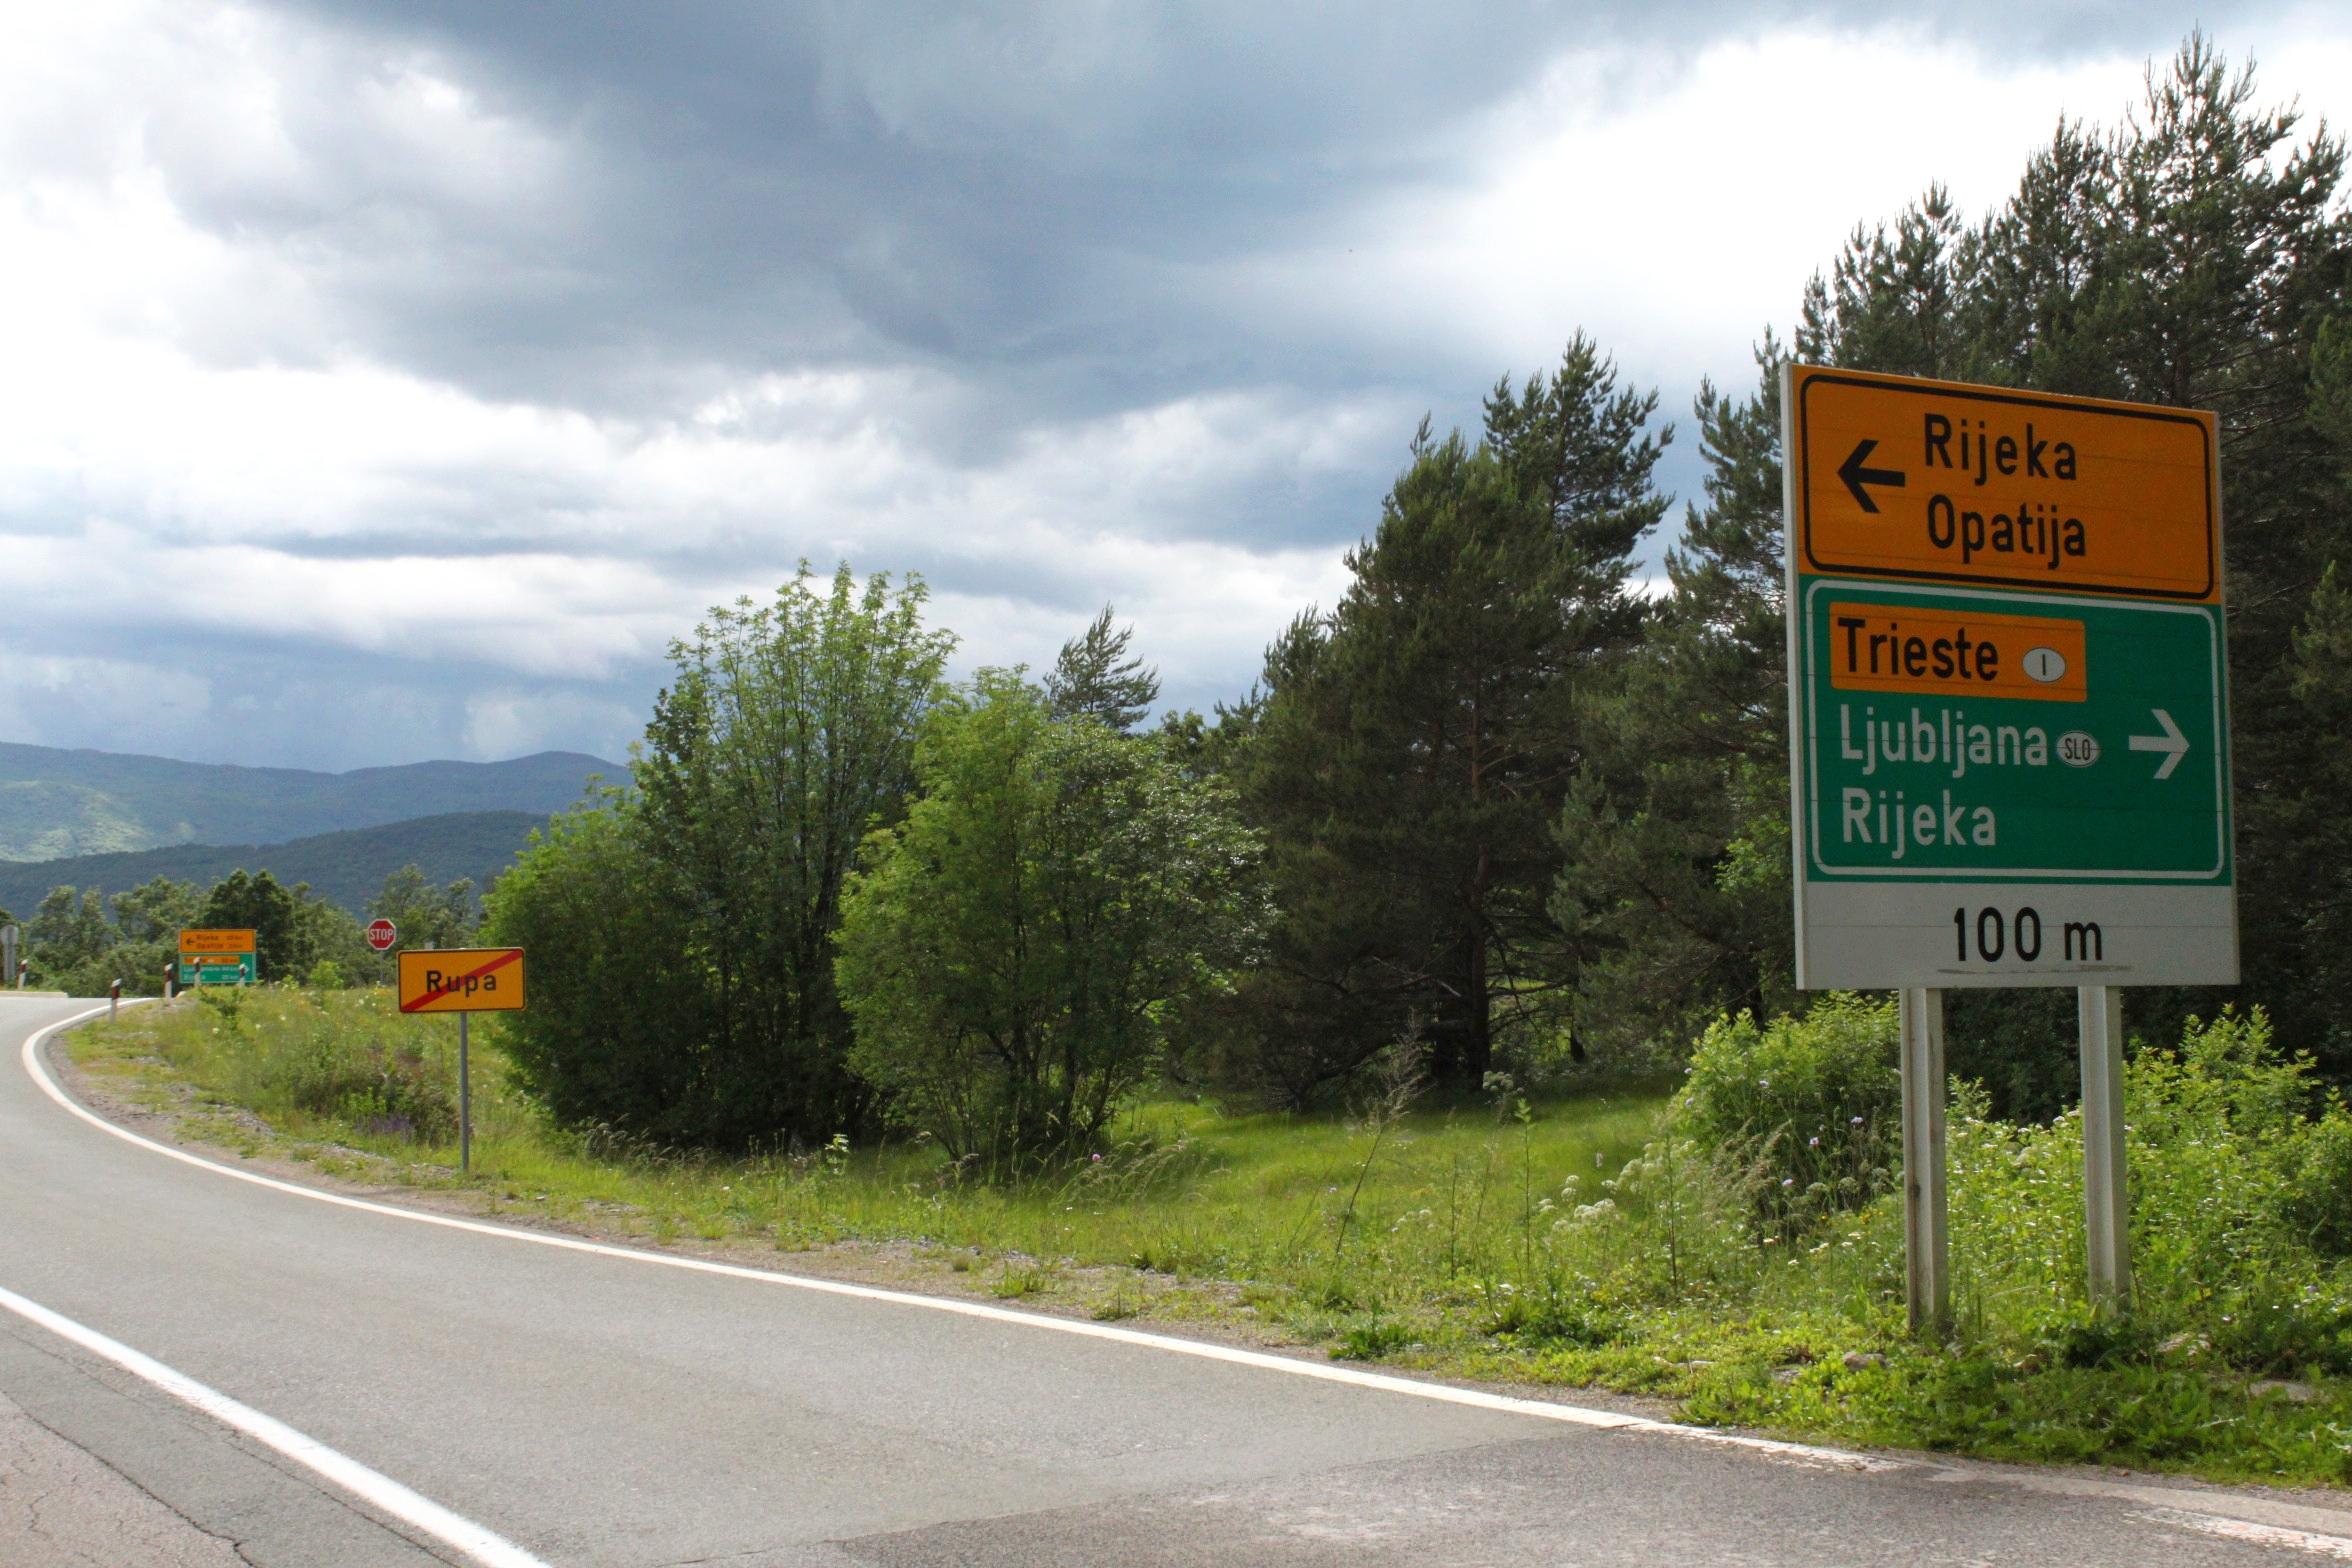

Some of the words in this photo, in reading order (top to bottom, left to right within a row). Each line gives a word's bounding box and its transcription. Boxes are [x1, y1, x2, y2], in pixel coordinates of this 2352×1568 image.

[1924, 412, 2077, 487] Rijeka
[1927, 494, 2086, 570] Opatija
[1837, 616, 1999, 681] Trieste
[1840, 704, 2049, 778] Ljubljana
[2063, 737, 2091, 762] SLO
[1842, 787, 1996, 859] Rijeka
[369, 928, 395, 941] STOP
[1953, 906, 2041, 962] 100
[2063, 921, 2102, 961] m
[427, 970, 496, 997] Rupa
